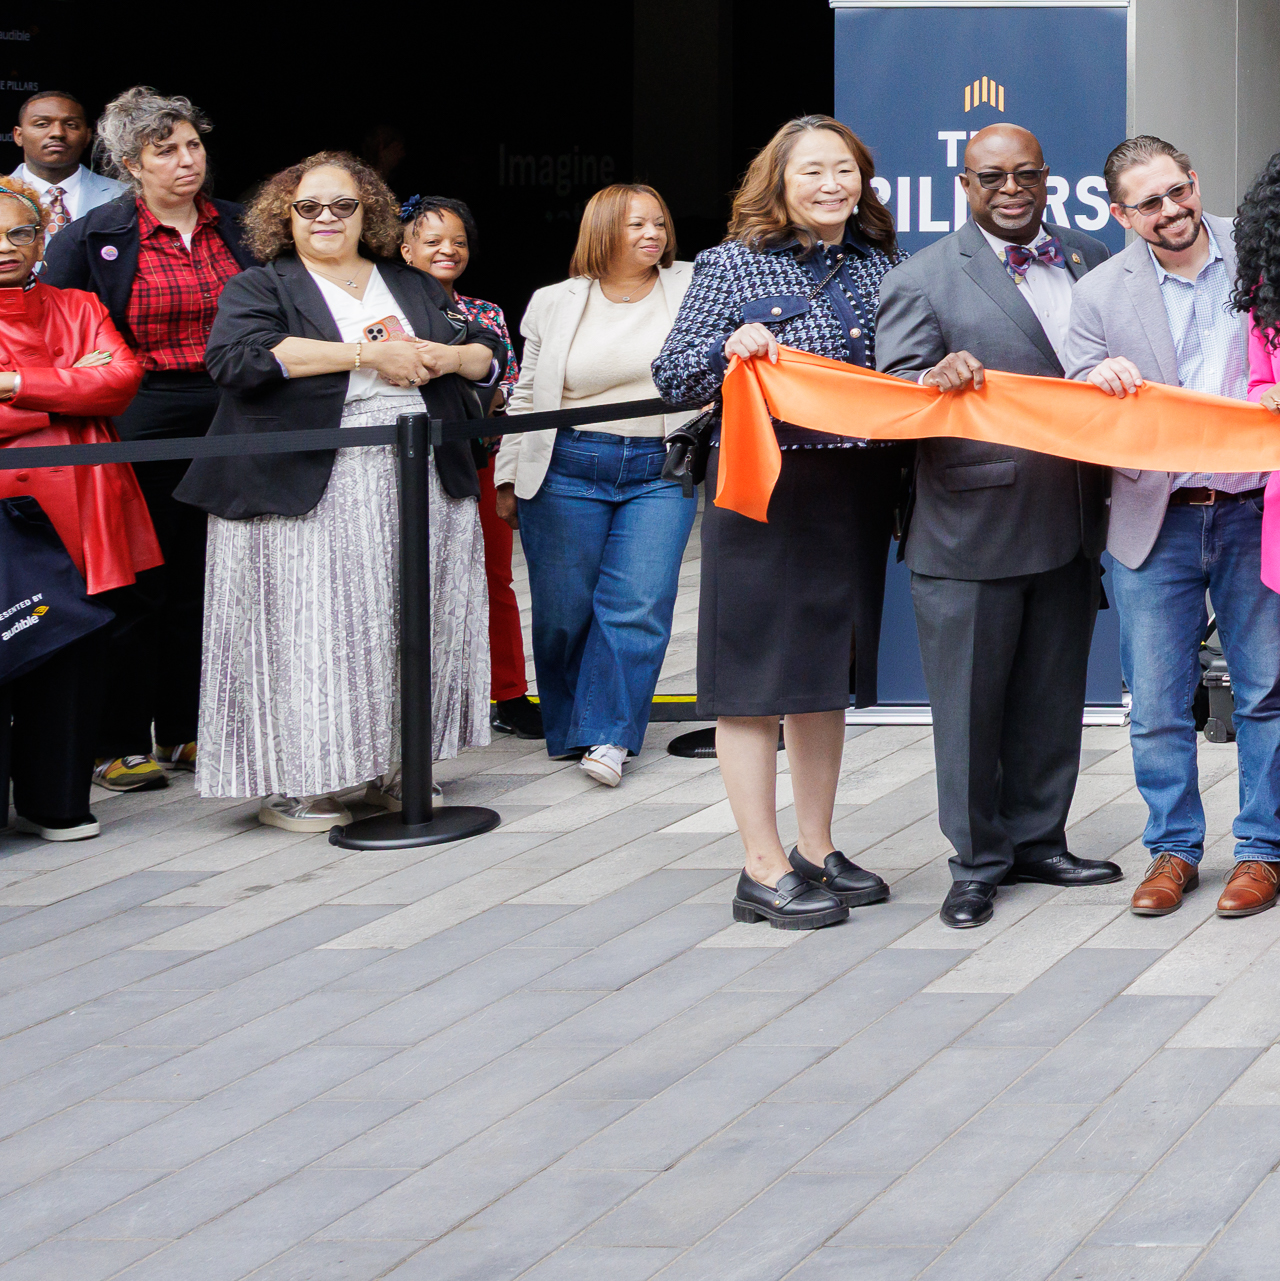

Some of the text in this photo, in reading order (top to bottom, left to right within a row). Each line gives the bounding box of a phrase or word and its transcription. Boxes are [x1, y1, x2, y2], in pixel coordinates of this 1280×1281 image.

[6, 81, 39, 91] PILLARS
[498, 143, 616, 197] Imagine
[0, 593, 43, 621] ESENTED BY
[1, 615, 40, 641] audible
